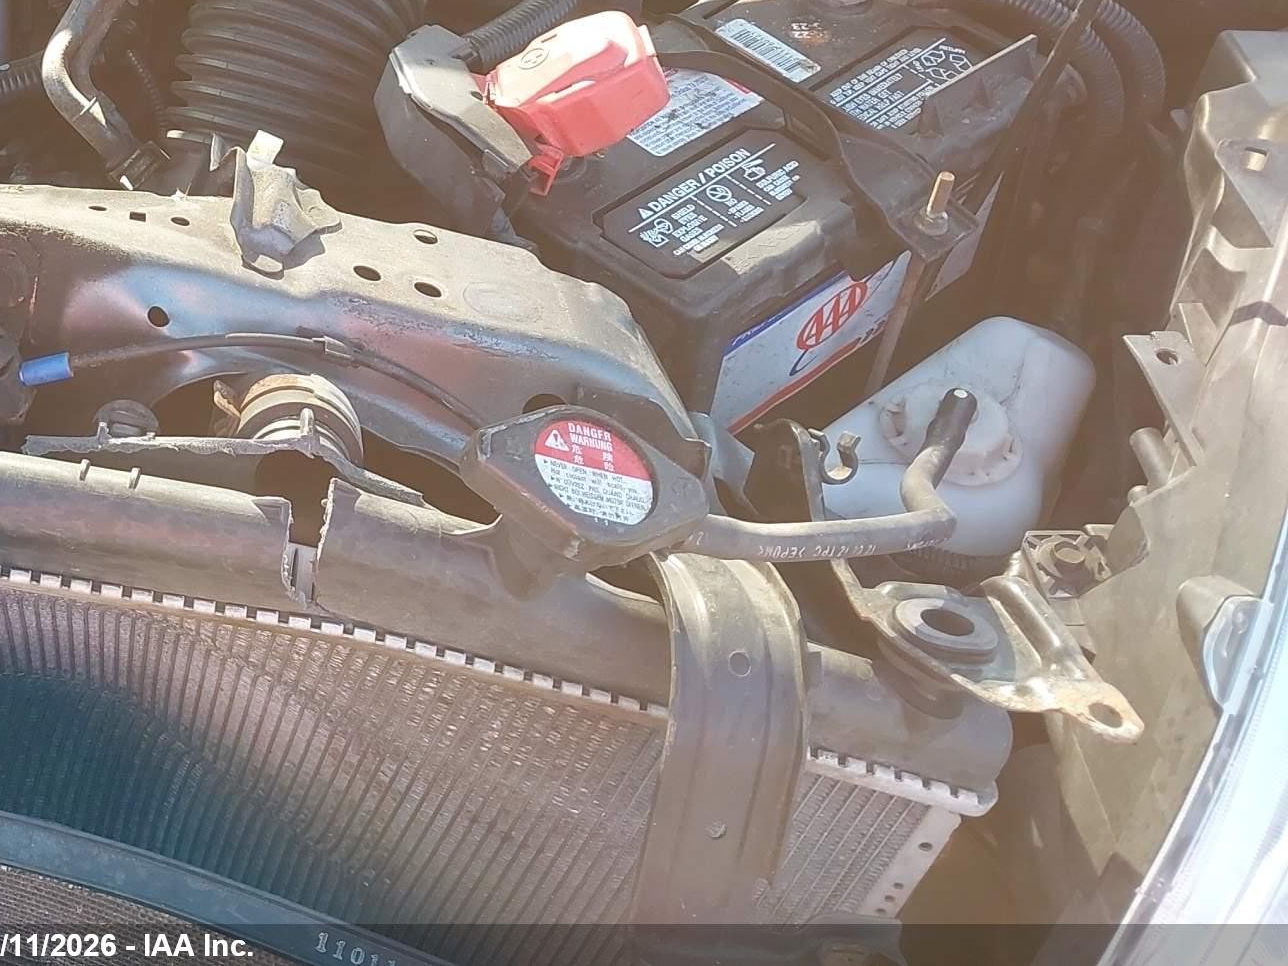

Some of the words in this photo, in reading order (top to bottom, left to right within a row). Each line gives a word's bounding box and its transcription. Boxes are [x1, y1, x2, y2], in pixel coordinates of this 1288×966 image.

[647, 179, 701, 212] DANGER
[697, 173, 707, 184] /
[705, 148, 751, 178] POISON
[671, 204, 696, 220] SHIELD
[567, 423, 612, 442] DANGER
[569, 433, 613, 452] WARNUNG
